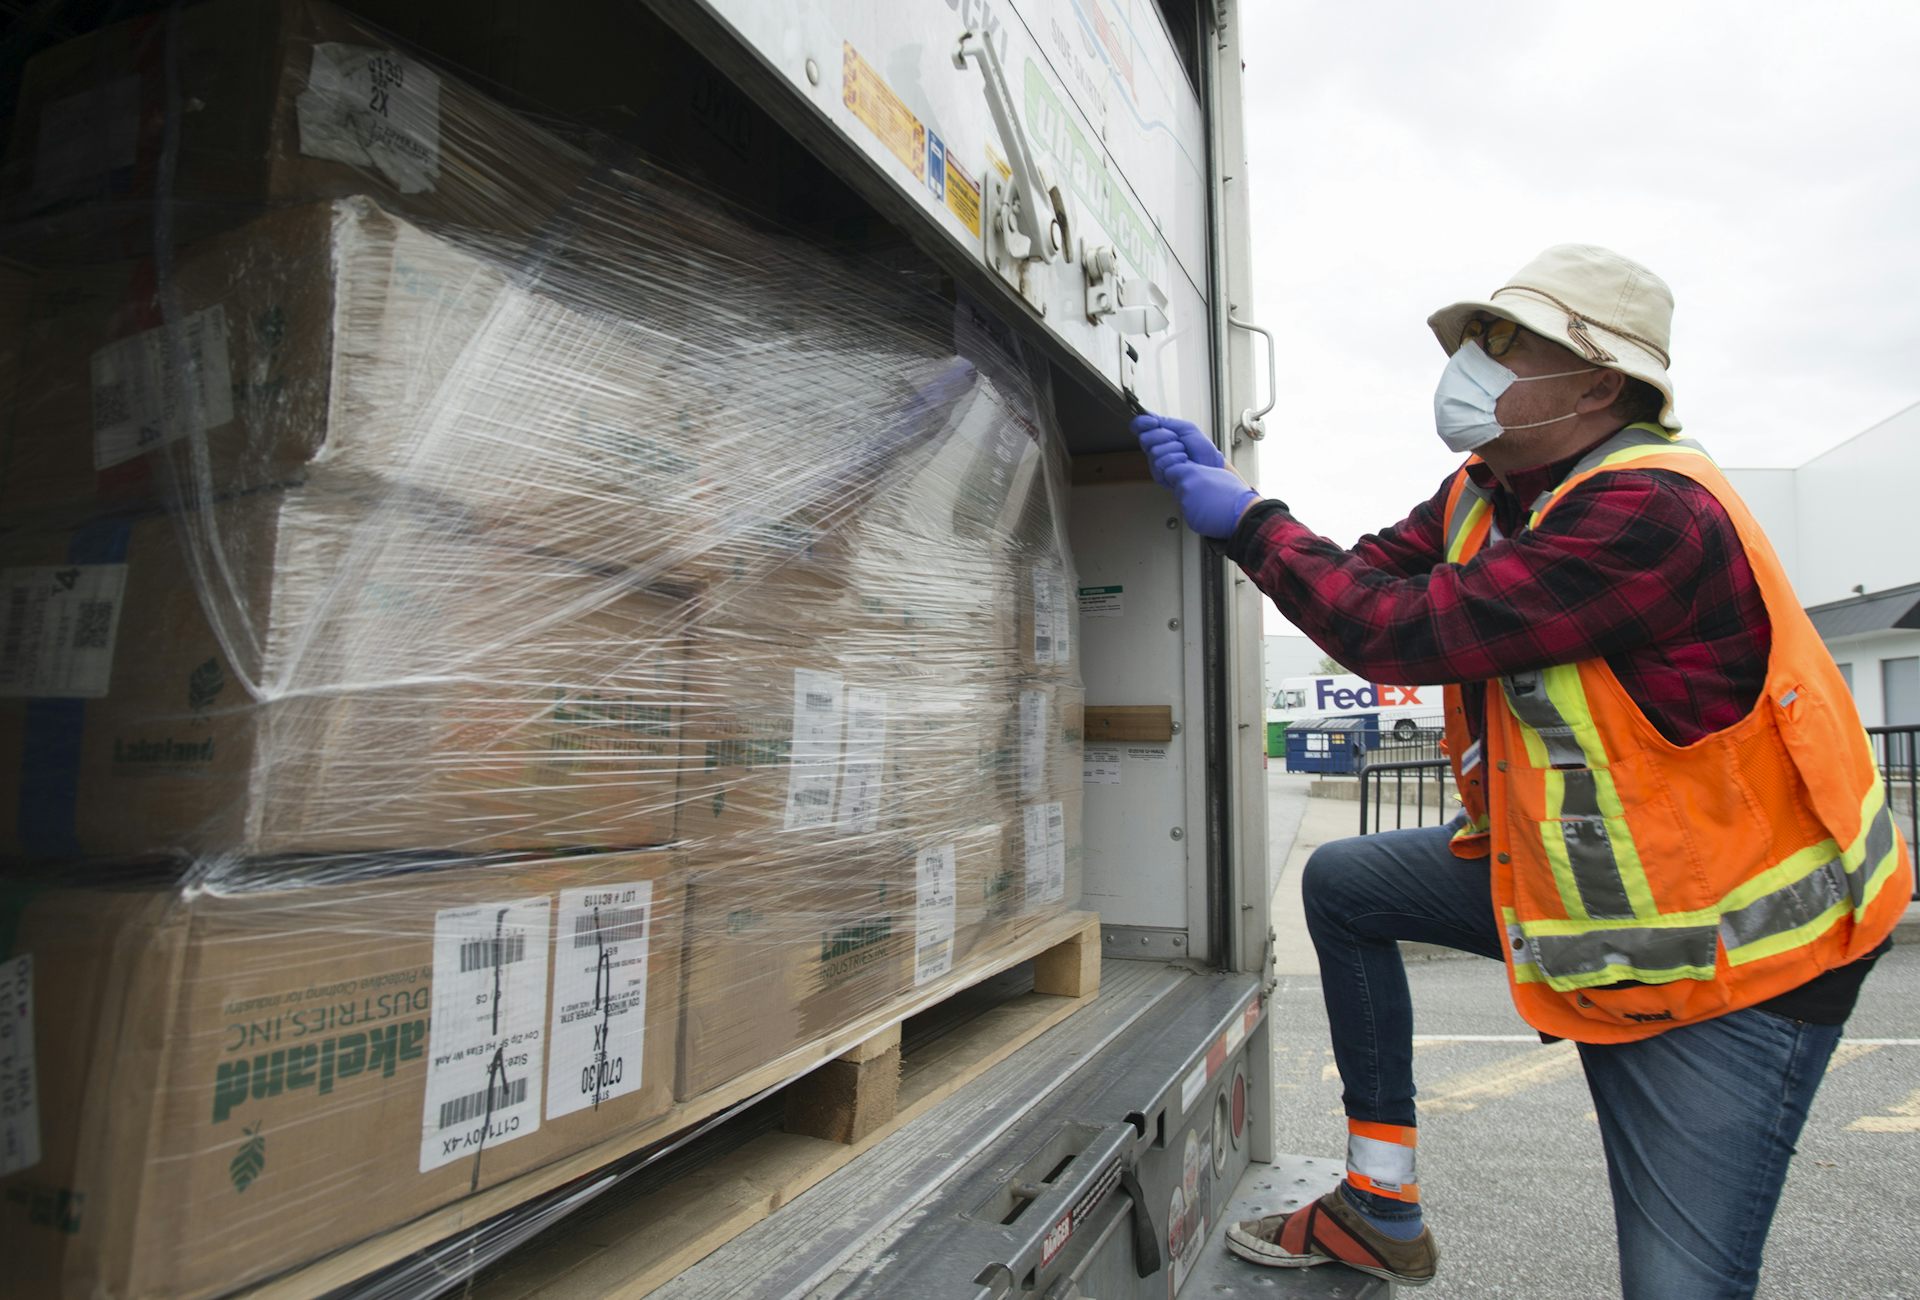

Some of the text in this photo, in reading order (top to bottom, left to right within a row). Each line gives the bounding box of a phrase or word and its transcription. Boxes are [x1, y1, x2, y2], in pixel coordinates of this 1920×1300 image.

[1315, 679, 1423, 710] FedEx
[621, 890, 636, 903] LOT
[306, 981, 358, 1001] Clothing
[362, 970, 417, 991] Protective
[284, 991, 303, 1004] for
[211, 1018, 431, 1125] akeland
[443, 1116, 520, 1156] C1T10Y-4X
